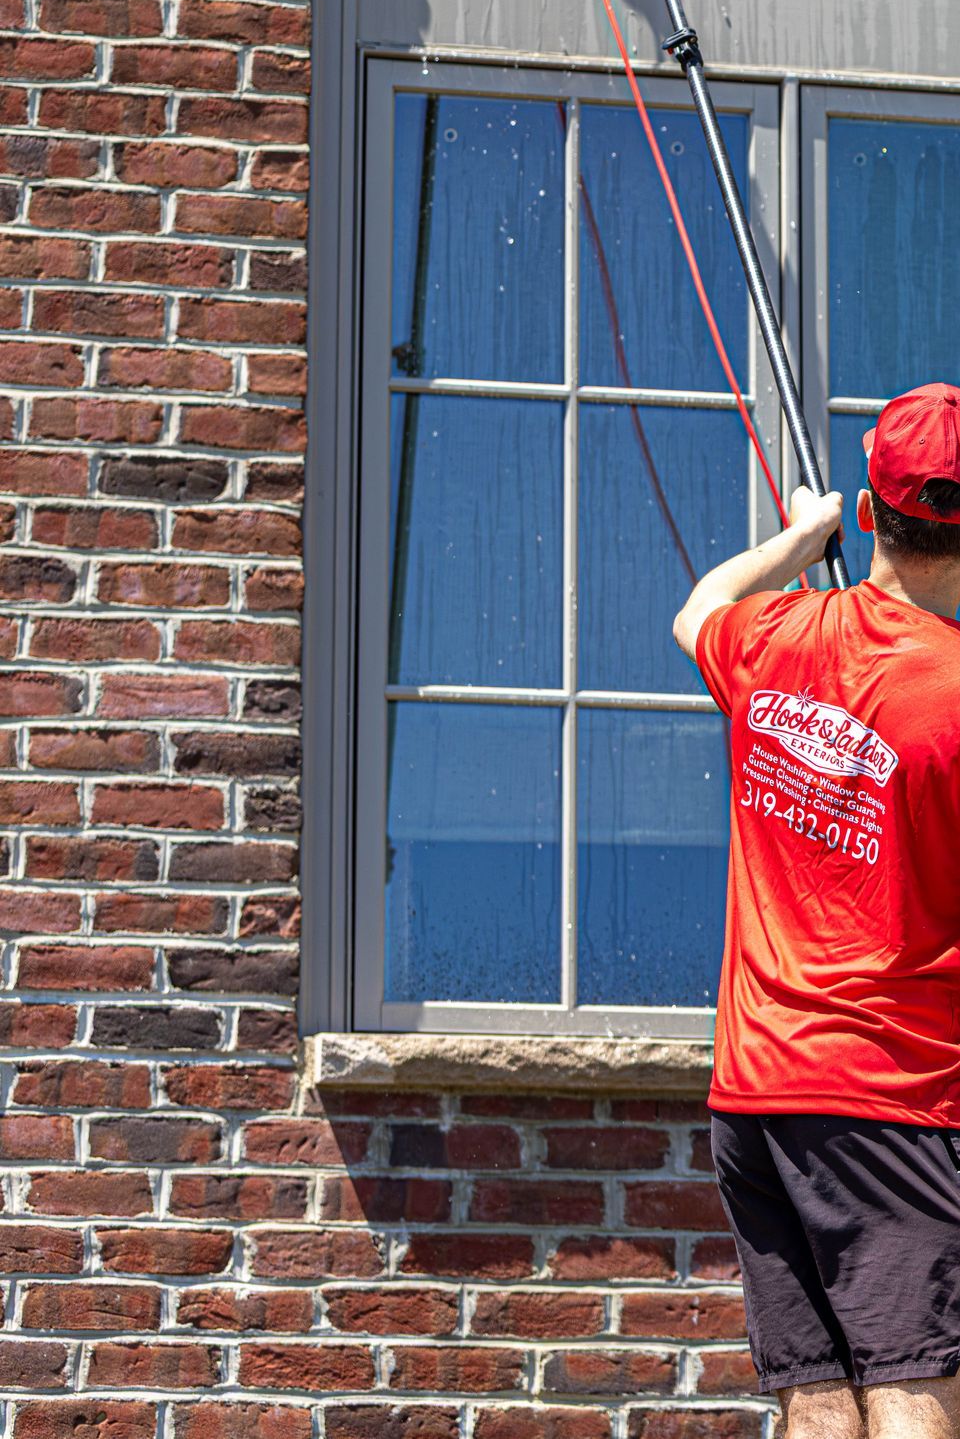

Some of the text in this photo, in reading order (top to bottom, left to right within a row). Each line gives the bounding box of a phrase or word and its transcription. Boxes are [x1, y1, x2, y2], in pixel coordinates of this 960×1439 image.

[748, 755, 877, 819] Gutter Cleaning Gutter Guards
[752, 744, 886, 815] House Washing Window Cleaning
[791, 739, 846, 769] EXTERIORS
[741, 780, 880, 865] 319-432-0150
[743, 763, 883, 835] Pressure Washing Christmas Lights
